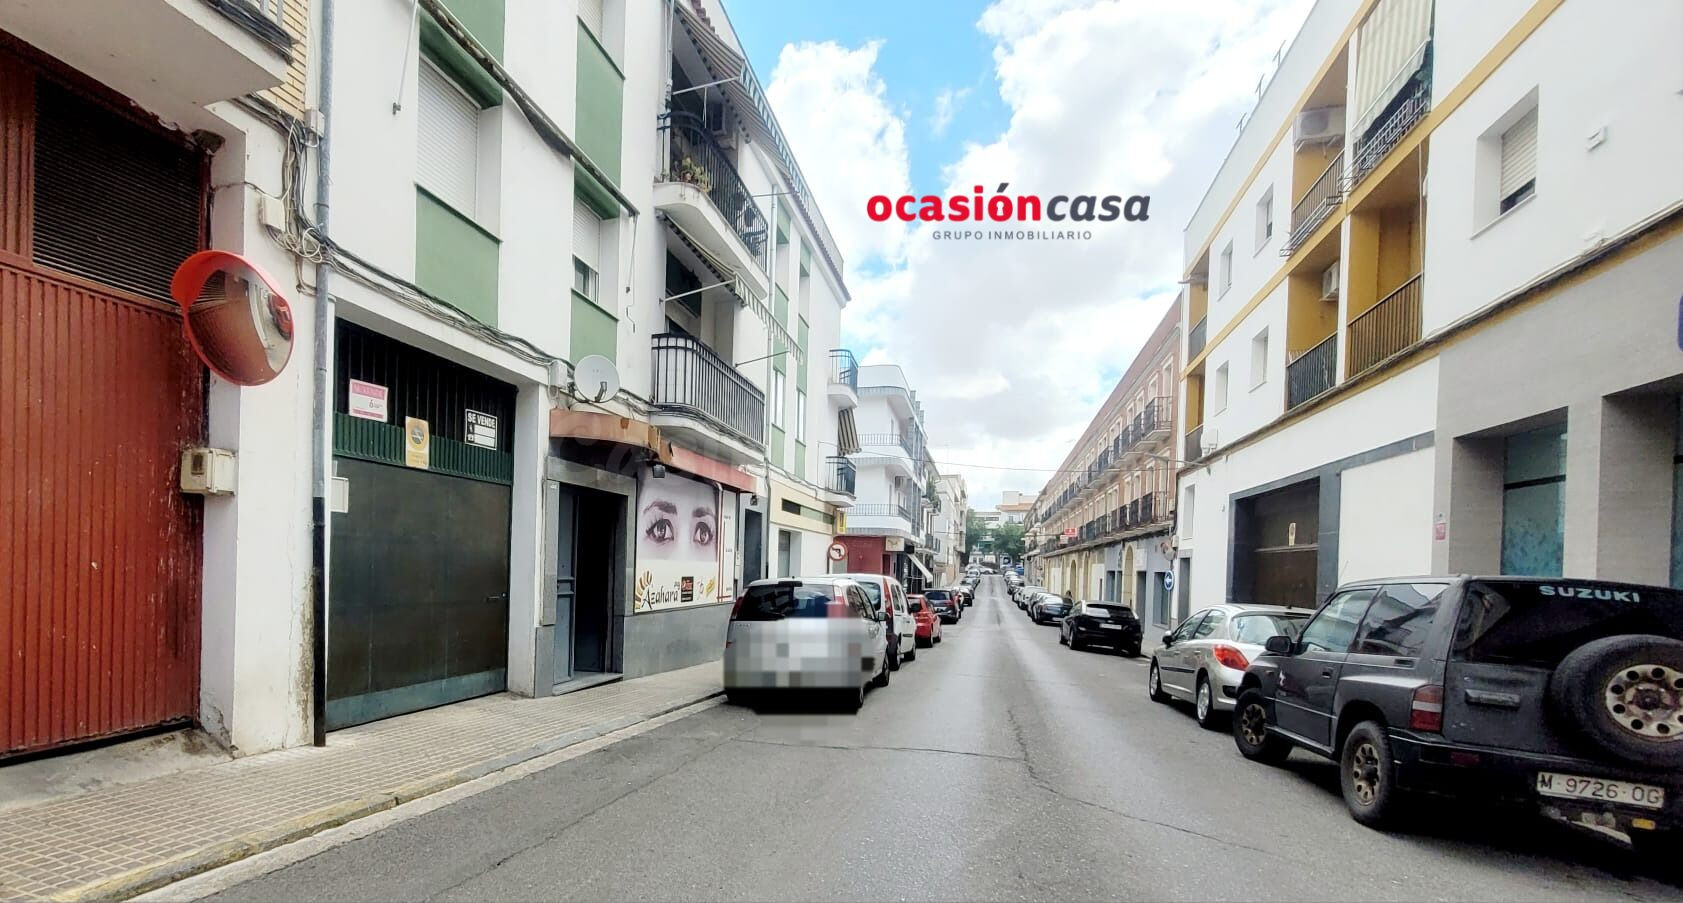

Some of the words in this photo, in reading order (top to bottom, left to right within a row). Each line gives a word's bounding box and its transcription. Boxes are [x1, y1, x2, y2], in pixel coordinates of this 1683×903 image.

[467, 412, 477, 424] SE
[477, 415, 496, 428] VENDE
[641, 585, 678, 610] Azahara
[1539, 585, 1641, 603] SUZUKI
